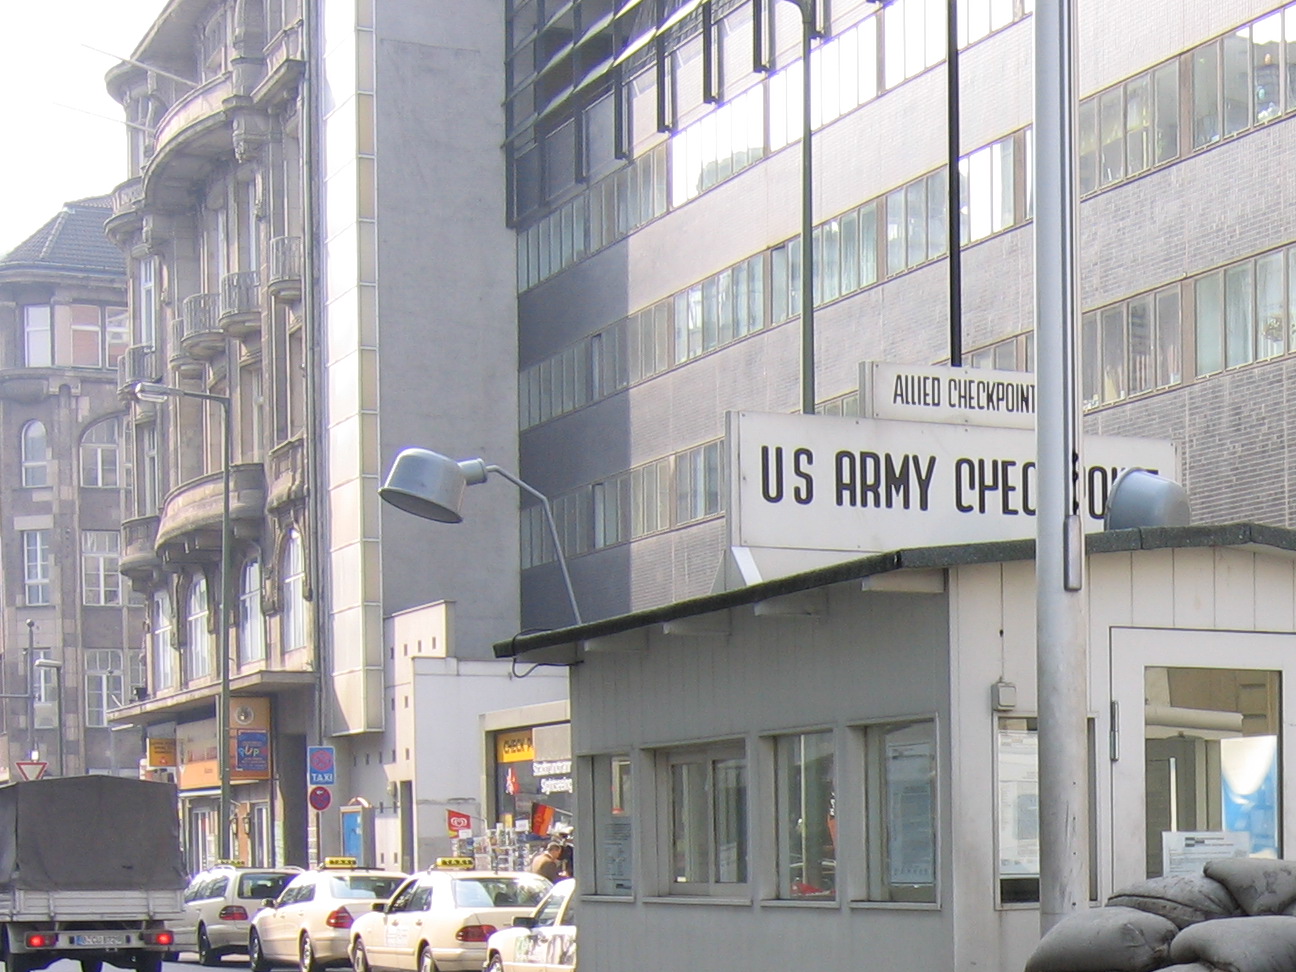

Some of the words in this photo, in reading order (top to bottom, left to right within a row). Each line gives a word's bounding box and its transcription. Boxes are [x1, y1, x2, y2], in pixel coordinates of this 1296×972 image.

[893, 374, 941, 407] ALLIED
[948, 378, 1036, 414] CHECKPOINT
[761, 445, 814, 505] US
[835, 450, 937, 511] ARMY
[311, 773, 333, 782] TAXI
